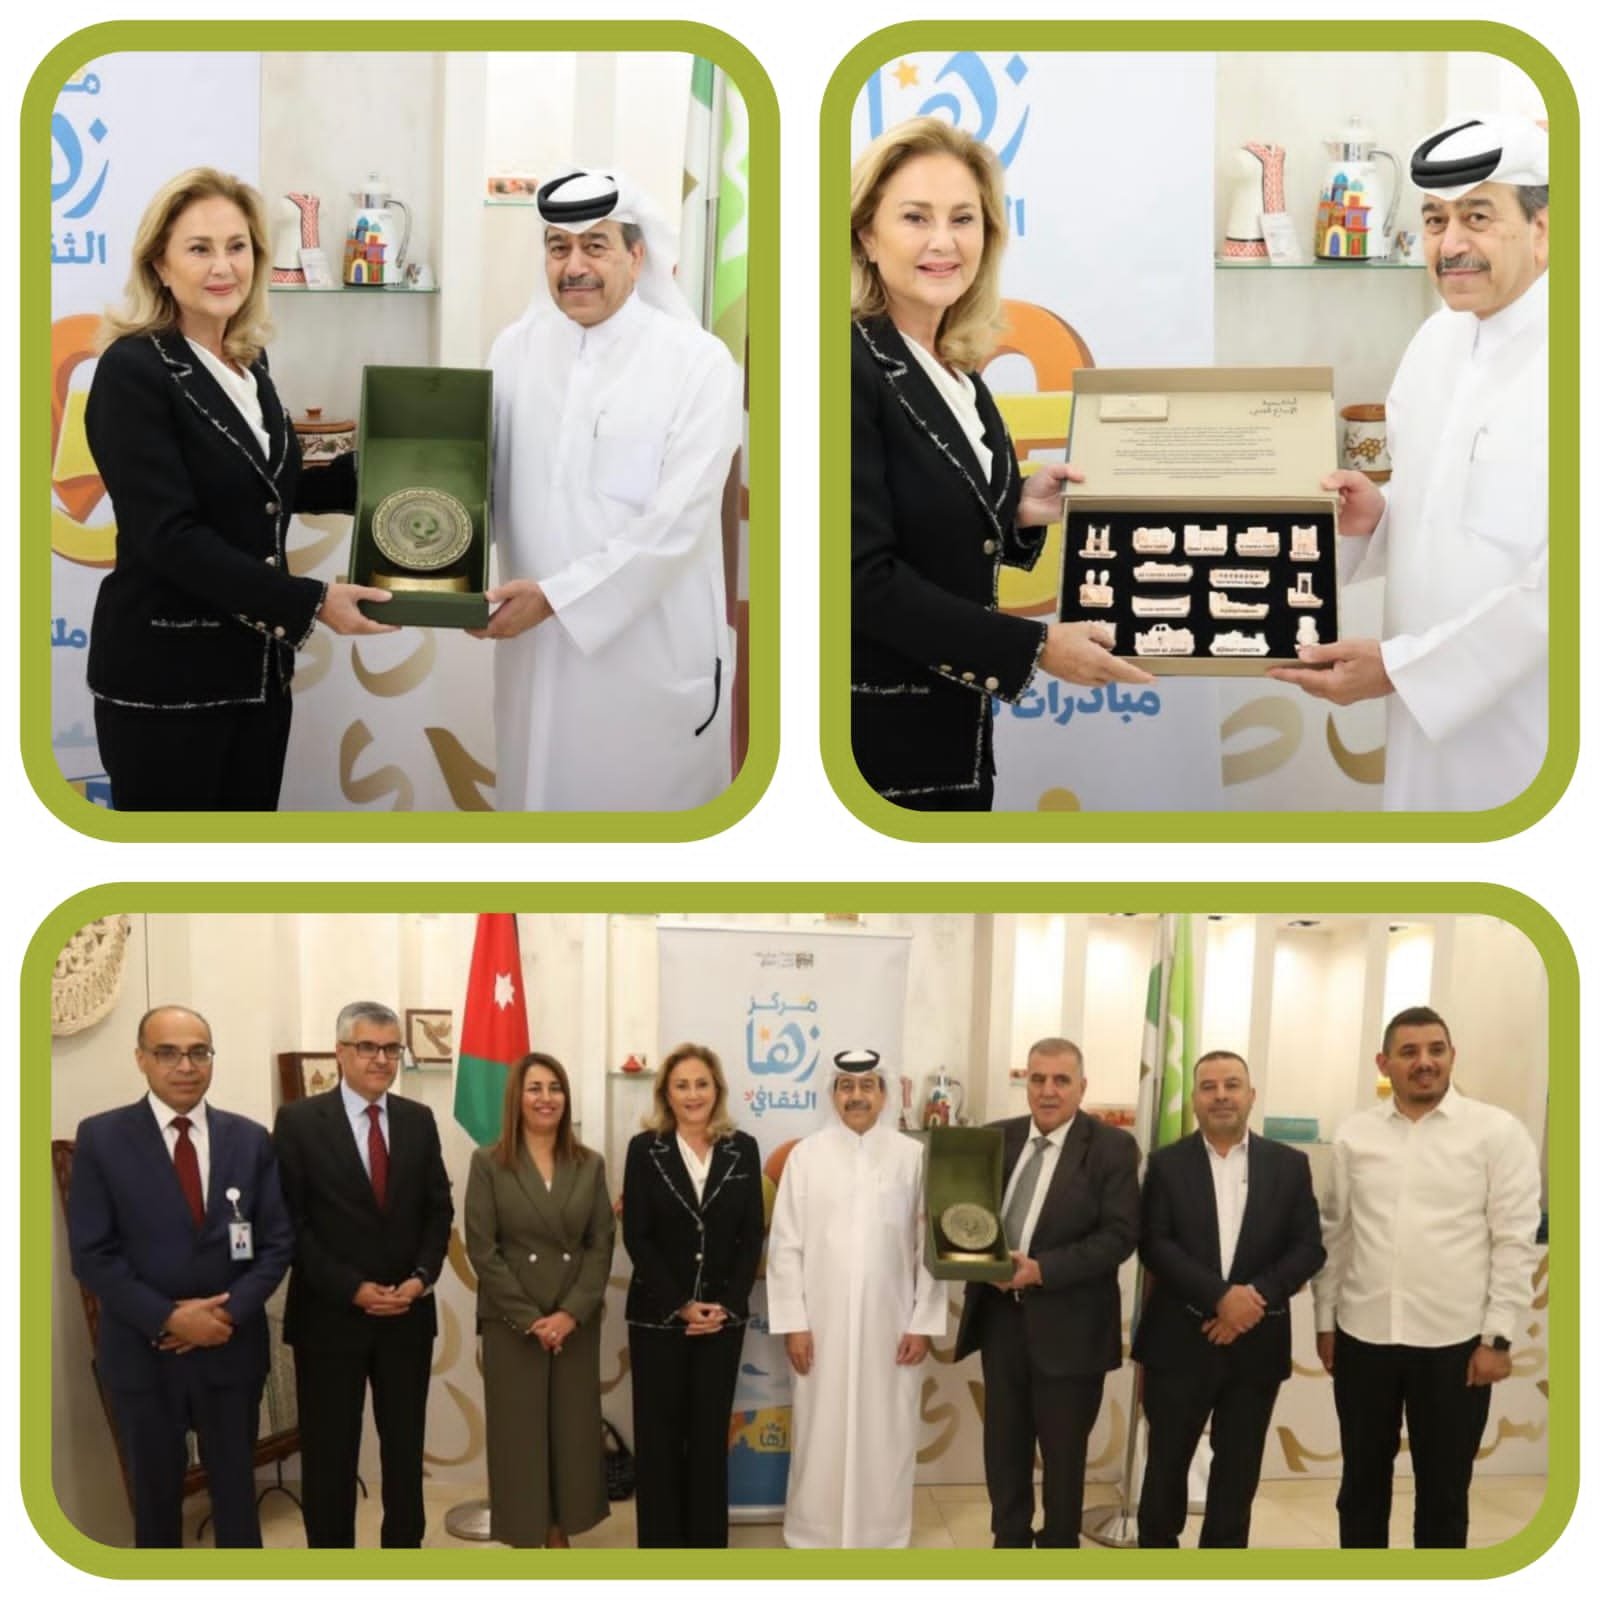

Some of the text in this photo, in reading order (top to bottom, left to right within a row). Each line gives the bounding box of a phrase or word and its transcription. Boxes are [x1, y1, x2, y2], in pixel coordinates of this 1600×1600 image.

[749, 992, 817, 1015] مركز
[746, 1018, 820, 1082] زها
[750, 1084, 817, 1117] الثقافي
